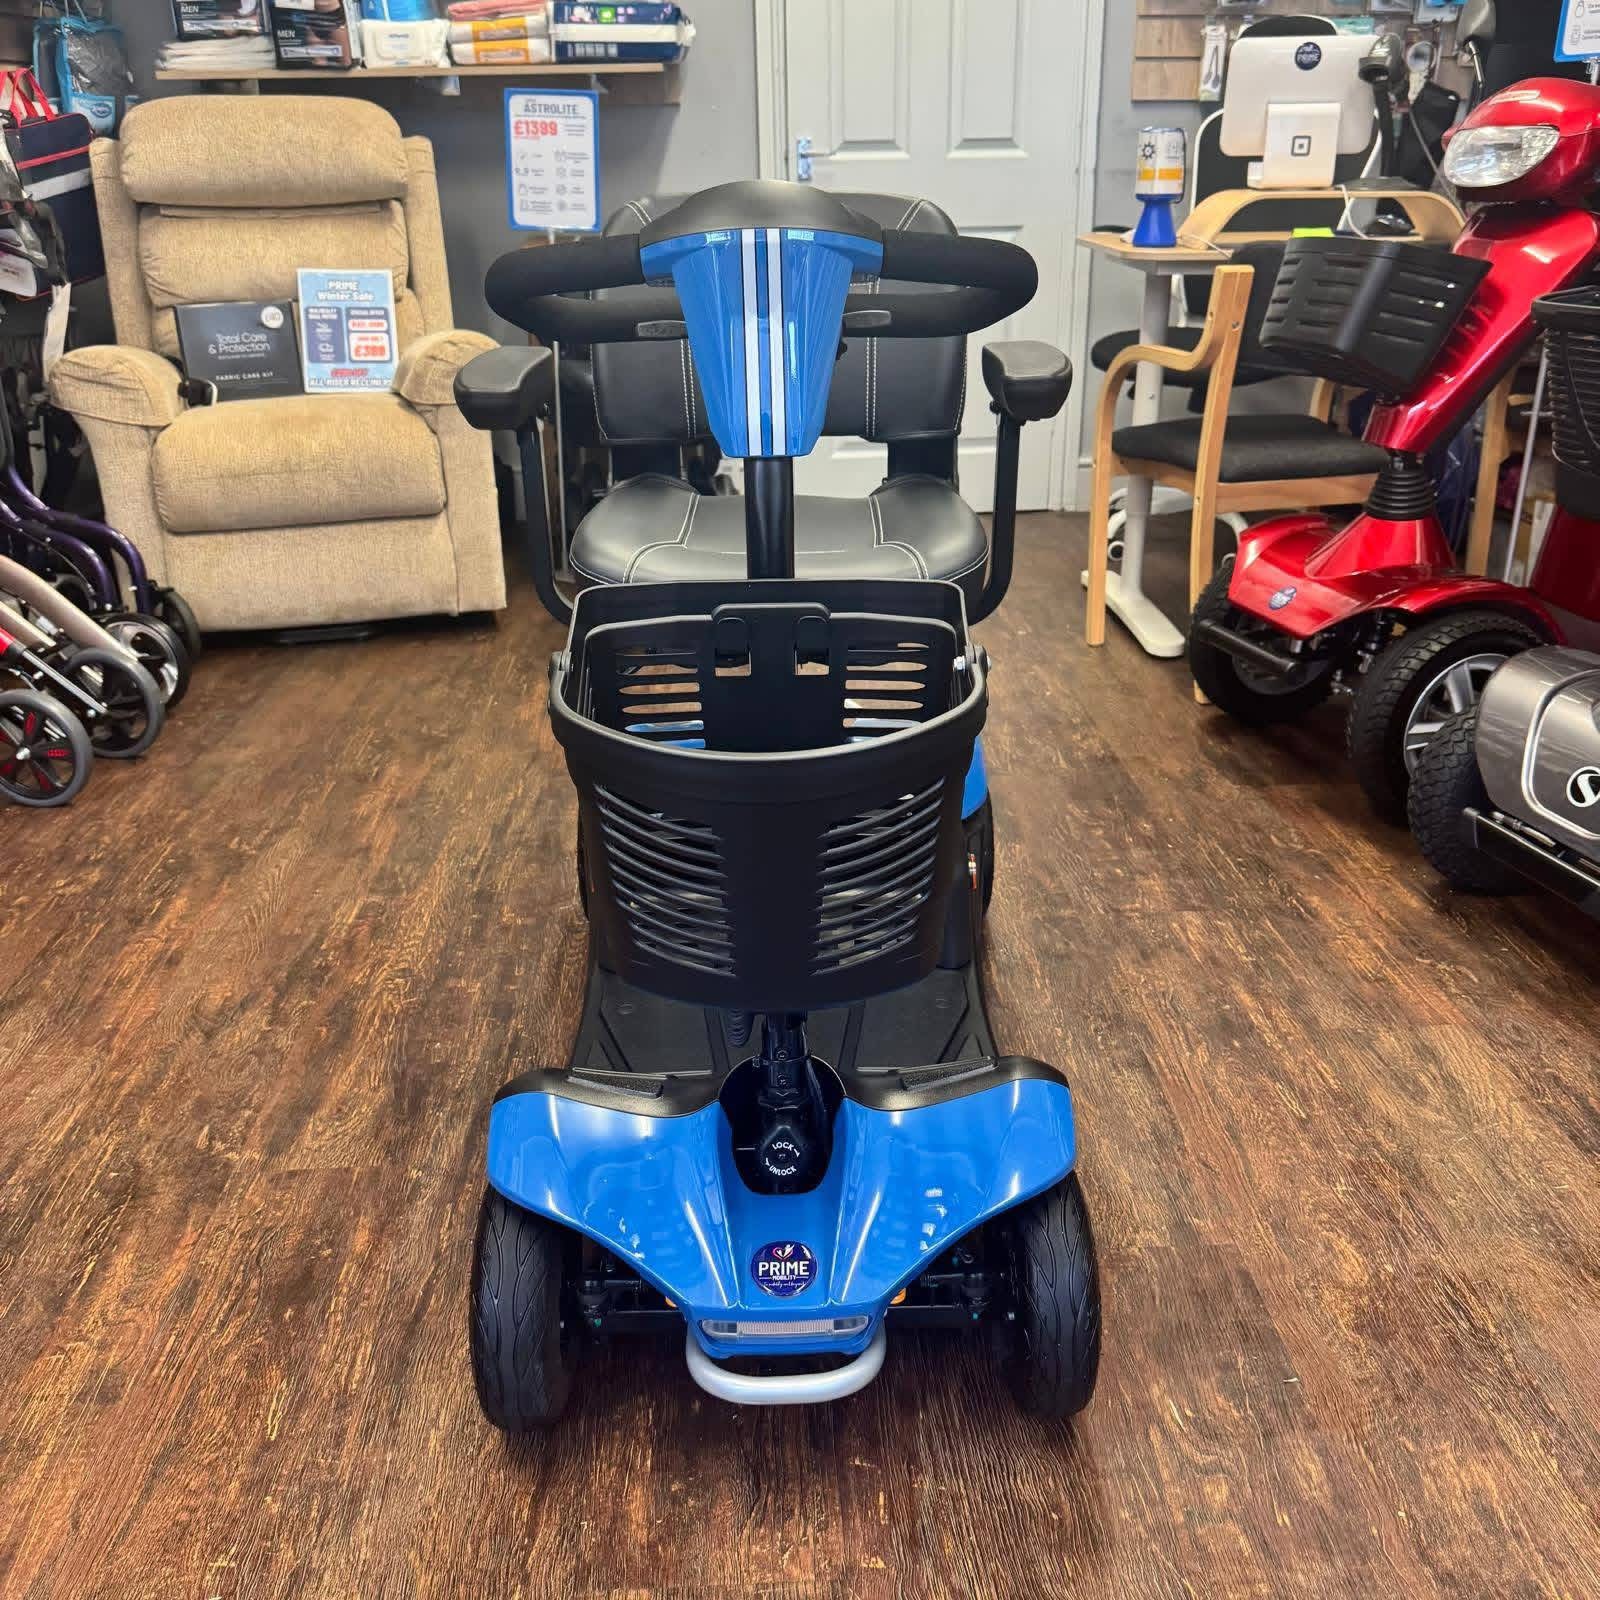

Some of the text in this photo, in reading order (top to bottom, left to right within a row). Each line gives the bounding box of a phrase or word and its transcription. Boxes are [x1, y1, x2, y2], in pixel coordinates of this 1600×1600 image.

[277, 30, 295, 38] MEN
[524, 103, 577, 114] ASTROLITE
[514, 120, 558, 136] £1399
[328, 280, 359, 291] PRIME
[317, 291, 374, 301] Winter Sale
[216, 332, 267, 343] Total Care
[208, 343, 271, 354] & Protection
[772, 1141, 794, 1151] LOCK
[769, 1165, 797, 1176] UNLOCK
[758, 1261, 810, 1276] PRIME
